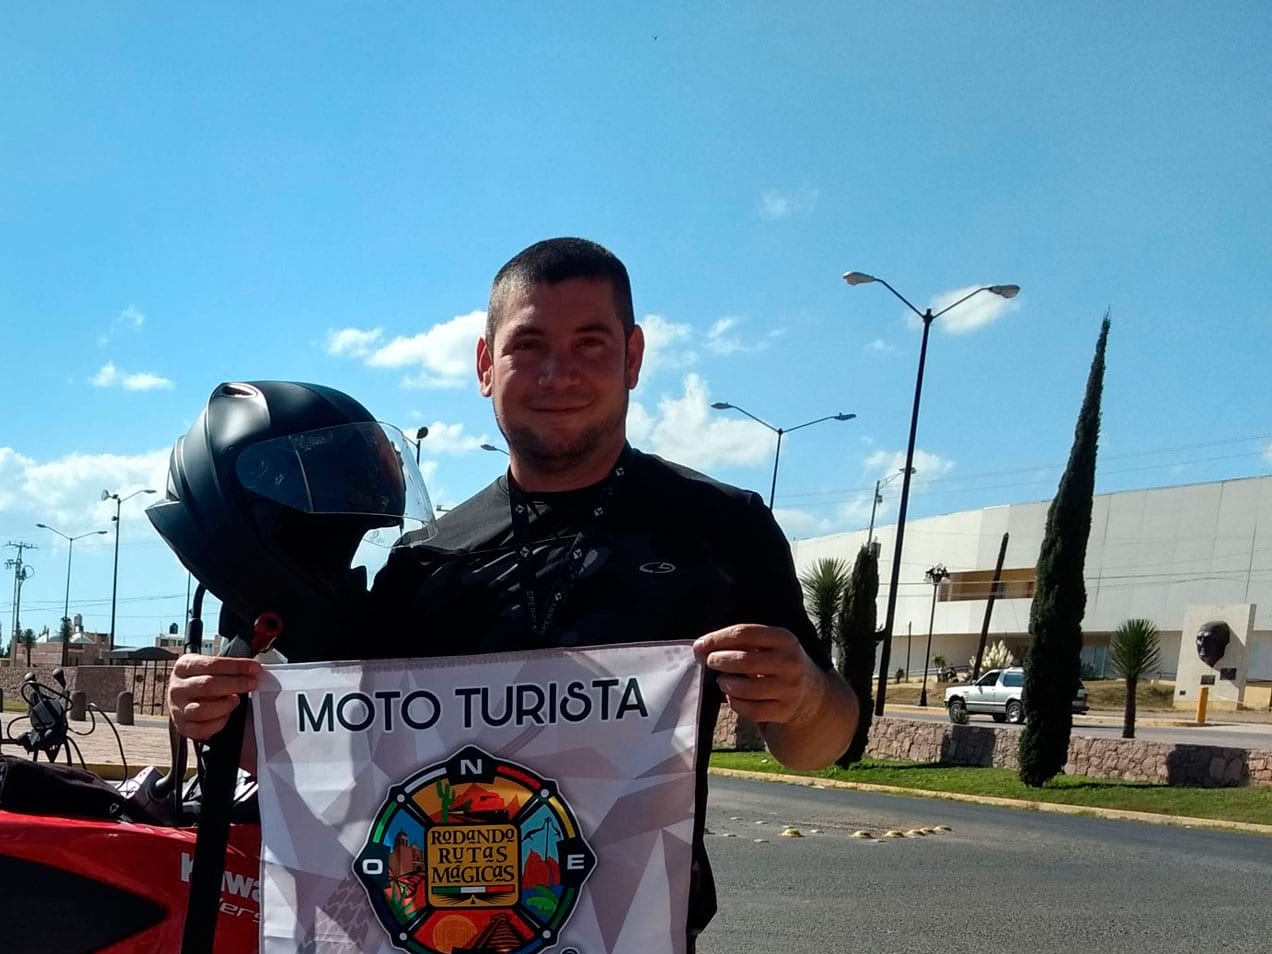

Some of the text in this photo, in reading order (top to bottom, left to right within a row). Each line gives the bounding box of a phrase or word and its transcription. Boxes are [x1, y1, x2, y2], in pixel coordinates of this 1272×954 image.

[298, 678, 649, 732] MOTO TURISTA
[460, 759, 483, 775] N
[362, 859, 383, 875] O
[567, 854, 585, 870] E
